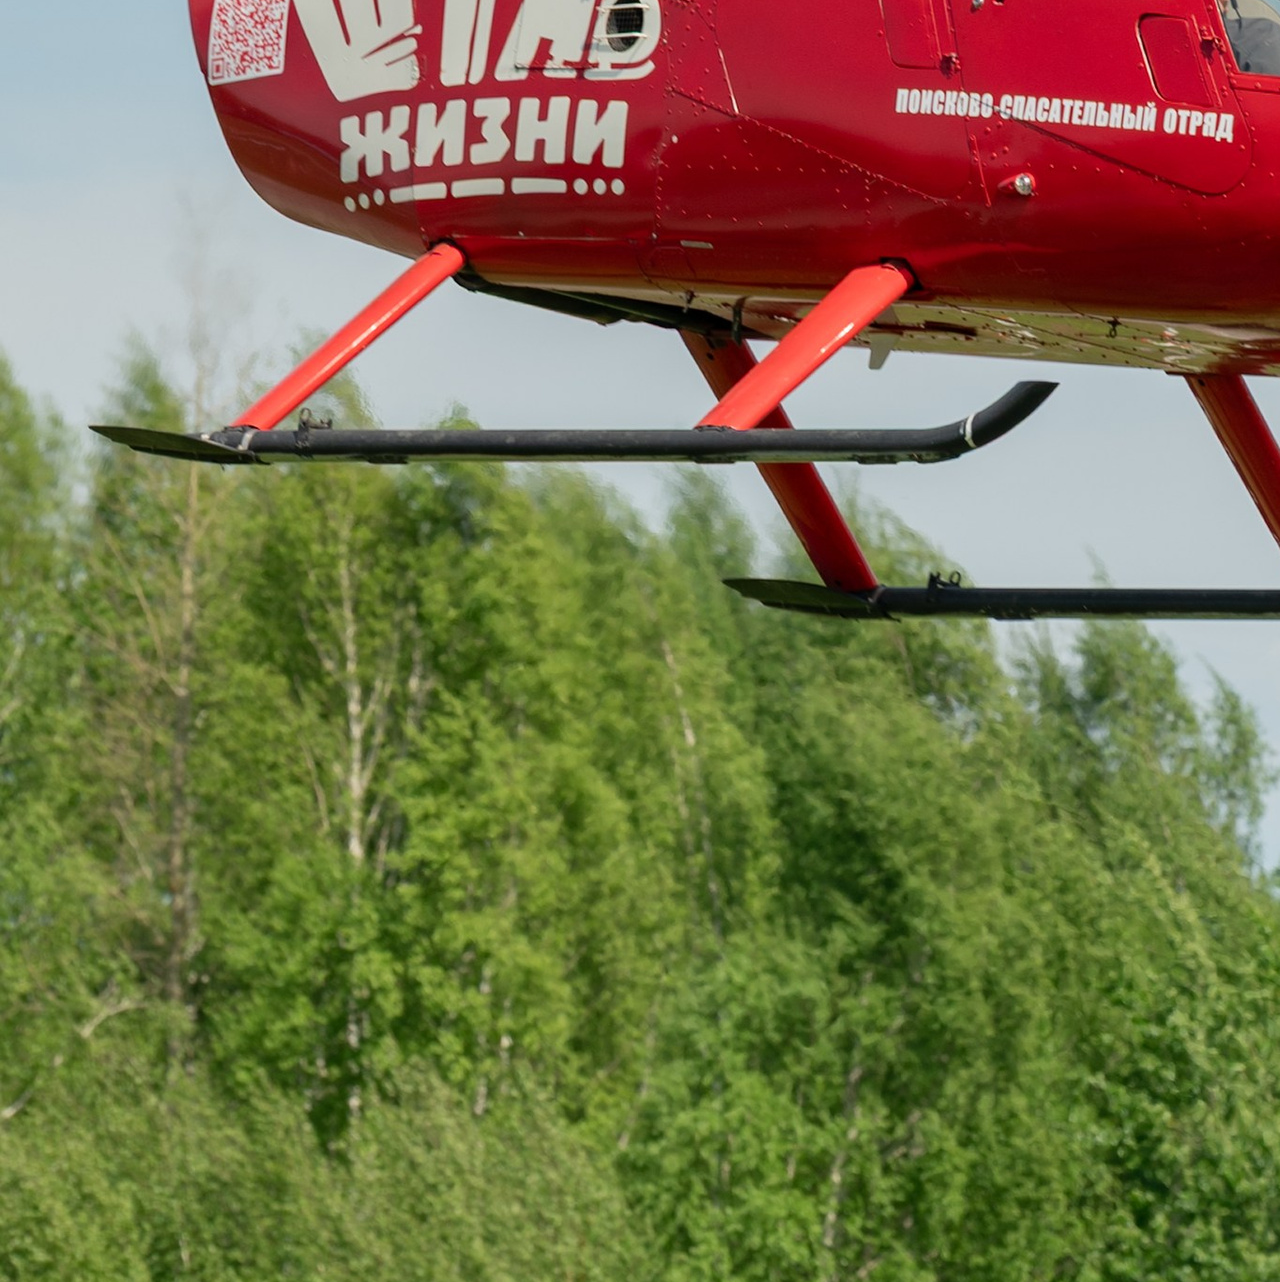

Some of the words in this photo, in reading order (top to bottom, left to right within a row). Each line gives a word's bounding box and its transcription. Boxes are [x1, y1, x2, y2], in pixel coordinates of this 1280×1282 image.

[339, 95, 629, 184] ЖИЗНИ
[895, 87, 1157, 132] ПОИСКОВО-СПАСАТЕЛЬНЫЙ
[1162, 107, 1235, 143] ОТРЯД
